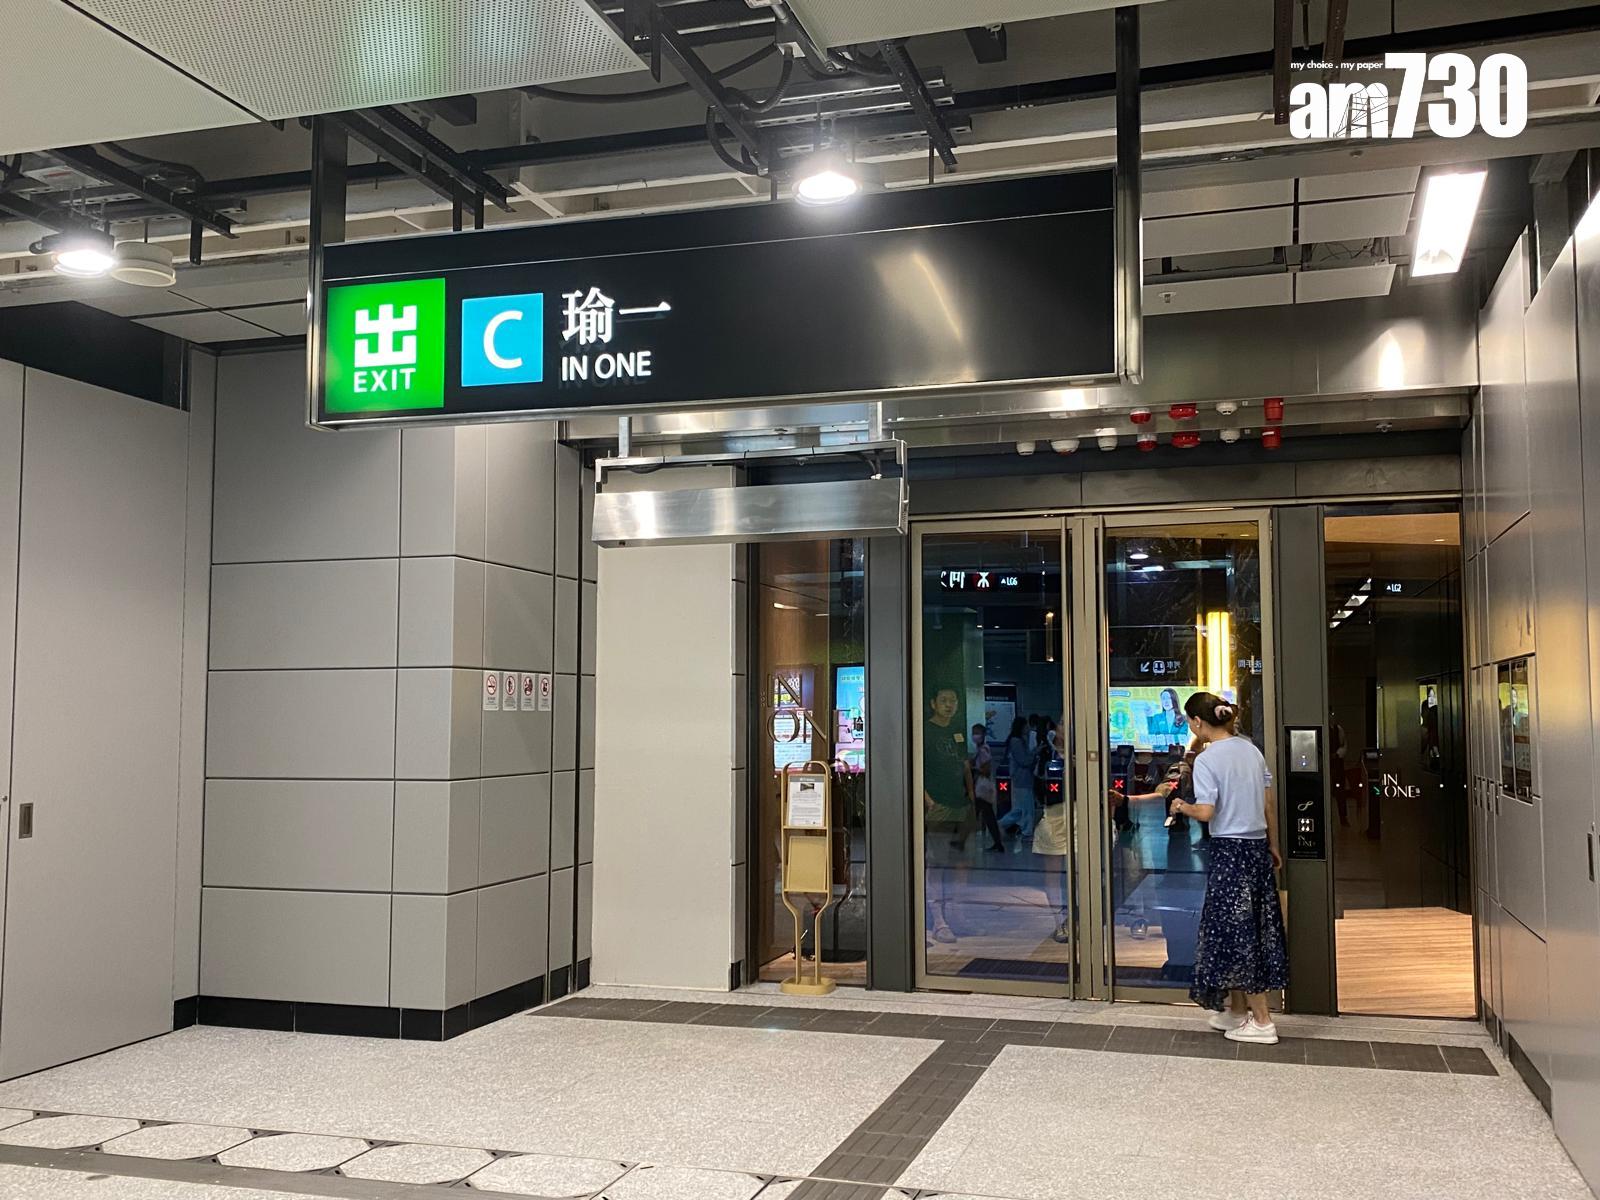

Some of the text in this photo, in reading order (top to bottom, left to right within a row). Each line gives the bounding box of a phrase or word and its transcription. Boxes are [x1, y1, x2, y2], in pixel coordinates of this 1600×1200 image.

[561, 286, 672, 346] 瑜一
[354, 304, 418, 367] 出
[482, 310, 524, 370] C
[353, 367, 417, 393] EXIT
[561, 350, 652, 382] IN ONE
[767, 673, 803, 708] IN
[766, 709, 852, 744] ONE
[1383, 773, 1398, 786] IN
[1384, 785, 1416, 798] ONE
